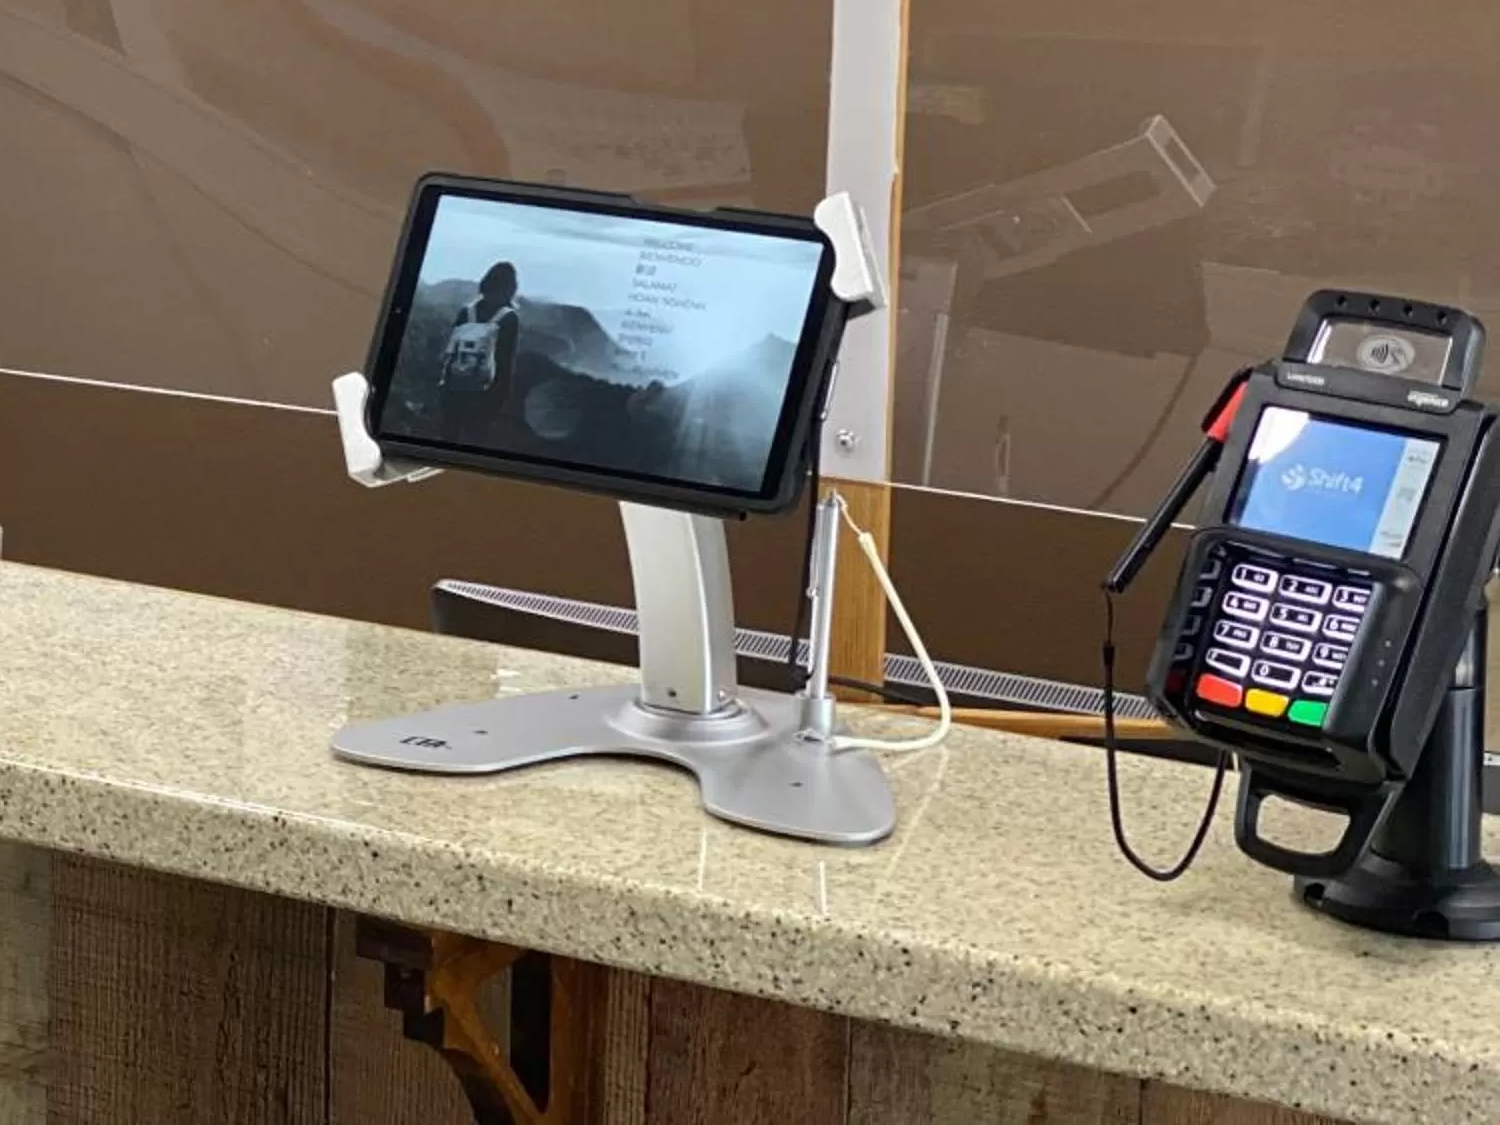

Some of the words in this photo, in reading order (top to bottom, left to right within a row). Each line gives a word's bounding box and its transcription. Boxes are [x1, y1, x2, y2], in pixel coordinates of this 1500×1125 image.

[1309, 467, 1364, 493] Shift4
[1240, 568, 1247, 580] 1
[1288, 580, 1298, 592] 2
[1339, 589, 1348, 602] 3
[1229, 596, 1239, 609] 4
[1279, 608, 1288, 621] 5
[1329, 618, 1338, 630] 6
[1220, 625, 1228, 636] 7
[1269, 635, 1279, 648] 8
[1259, 664, 1269, 676] 0
